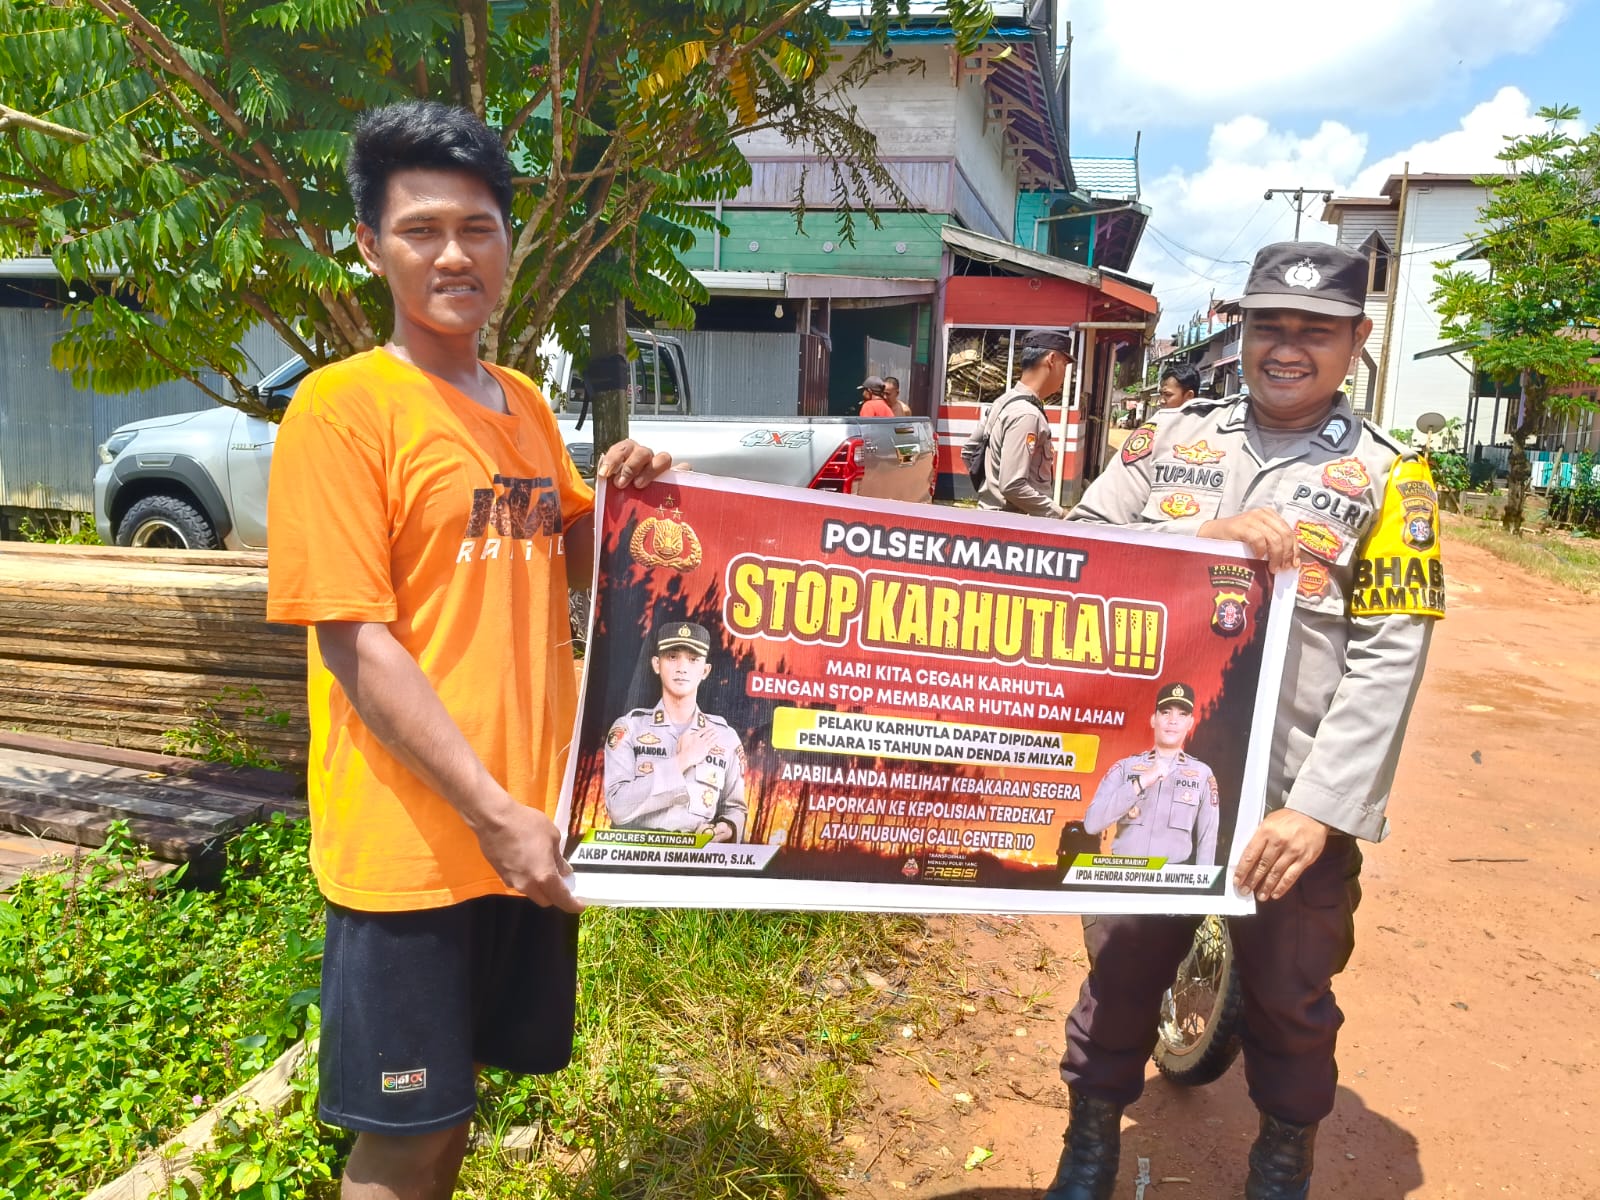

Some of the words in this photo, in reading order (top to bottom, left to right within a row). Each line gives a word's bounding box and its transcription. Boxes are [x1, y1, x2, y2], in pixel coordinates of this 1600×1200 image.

[1155, 465, 1224, 487] TUPANG
[1293, 485, 1370, 529] POLRI
[825, 523, 946, 563] POLSEK
[951, 539, 1084, 578] MARIKIT
[1353, 557, 1445, 590] BHAB
[732, 563, 858, 637] STOP
[867, 579, 1103, 664] KARHUTLA
[1114, 607, 1159, 669] !!!
[827, 660, 870, 679] MARI
[875, 665, 912, 683] KITA
[916, 669, 974, 688] CEGAH
[978, 676, 1064, 699] KARHUTLA
[751, 677, 824, 699] DENGAN
[829, 683, 874, 702] STOP
[877, 688, 974, 713] MEMBAKAR
[979, 697, 1035, 717] HUTAN
[1038, 704, 1072, 721] DAN
[1075, 708, 1125, 727] LAHAN
[818, 716, 872, 733] PELAKU
[876, 721, 949, 740] KARHUTLA
[953, 728, 996, 744] DAPAT
[999, 732, 1060, 749] DIPIDANA
[705, 755, 727, 769] OLRI
[799, 732, 865, 750] PENJARA
[868, 738, 880, 751] 15
[885, 740, 932, 755] TAHUN
[935, 745, 963, 759] DAN
[967, 748, 1010, 763] DENDA
[1014, 752, 1025, 764] 15
[1027, 753, 1073, 767] MILYAR
[782, 764, 843, 784] APABILA
[847, 768, 887, 787] ANDA
[890, 773, 949, 792] MELIHAT
[952, 780, 1030, 797] KEBAKARAN
[1032, 784, 1081, 800] SEGERA
[1176, 779, 1199, 789] POLRI
[809, 795, 885, 814] LAPORKAN
[889, 800, 906, 816] KE
[909, 801, 986, 820] KEPOLISIAN
[989, 806, 1054, 825] TERDEKAT
[595, 831, 645, 843] KAPOLRES
[648, 833, 694, 845] KATINGAN
[821, 823, 858, 840] ATAU
[861, 825, 924, 844] HUBUNGI
[927, 828, 959, 846] CALL
[963, 831, 1014, 849] CENTER
[1016, 833, 1034, 850] 110
[578, 847, 608, 860] AKBP
[610, 849, 661, 862] CHANDRA
[663, 851, 728, 866] ISMAWANTO,
[730, 854, 756, 865] S.I.K.
[1093, 857, 1123, 865] KAPOLSEK
[924, 866, 978, 878] PRESISI
[1076, 869, 1092, 880] IPDA
[1094, 870, 1123, 881] HENDRA
[1124, 871, 1154, 882] SOPIYAN
[1156, 873, 1163, 882] D.
[1164, 873, 1195, 885] MUNTHE,
[1197, 875, 1210, 884] S.H.
